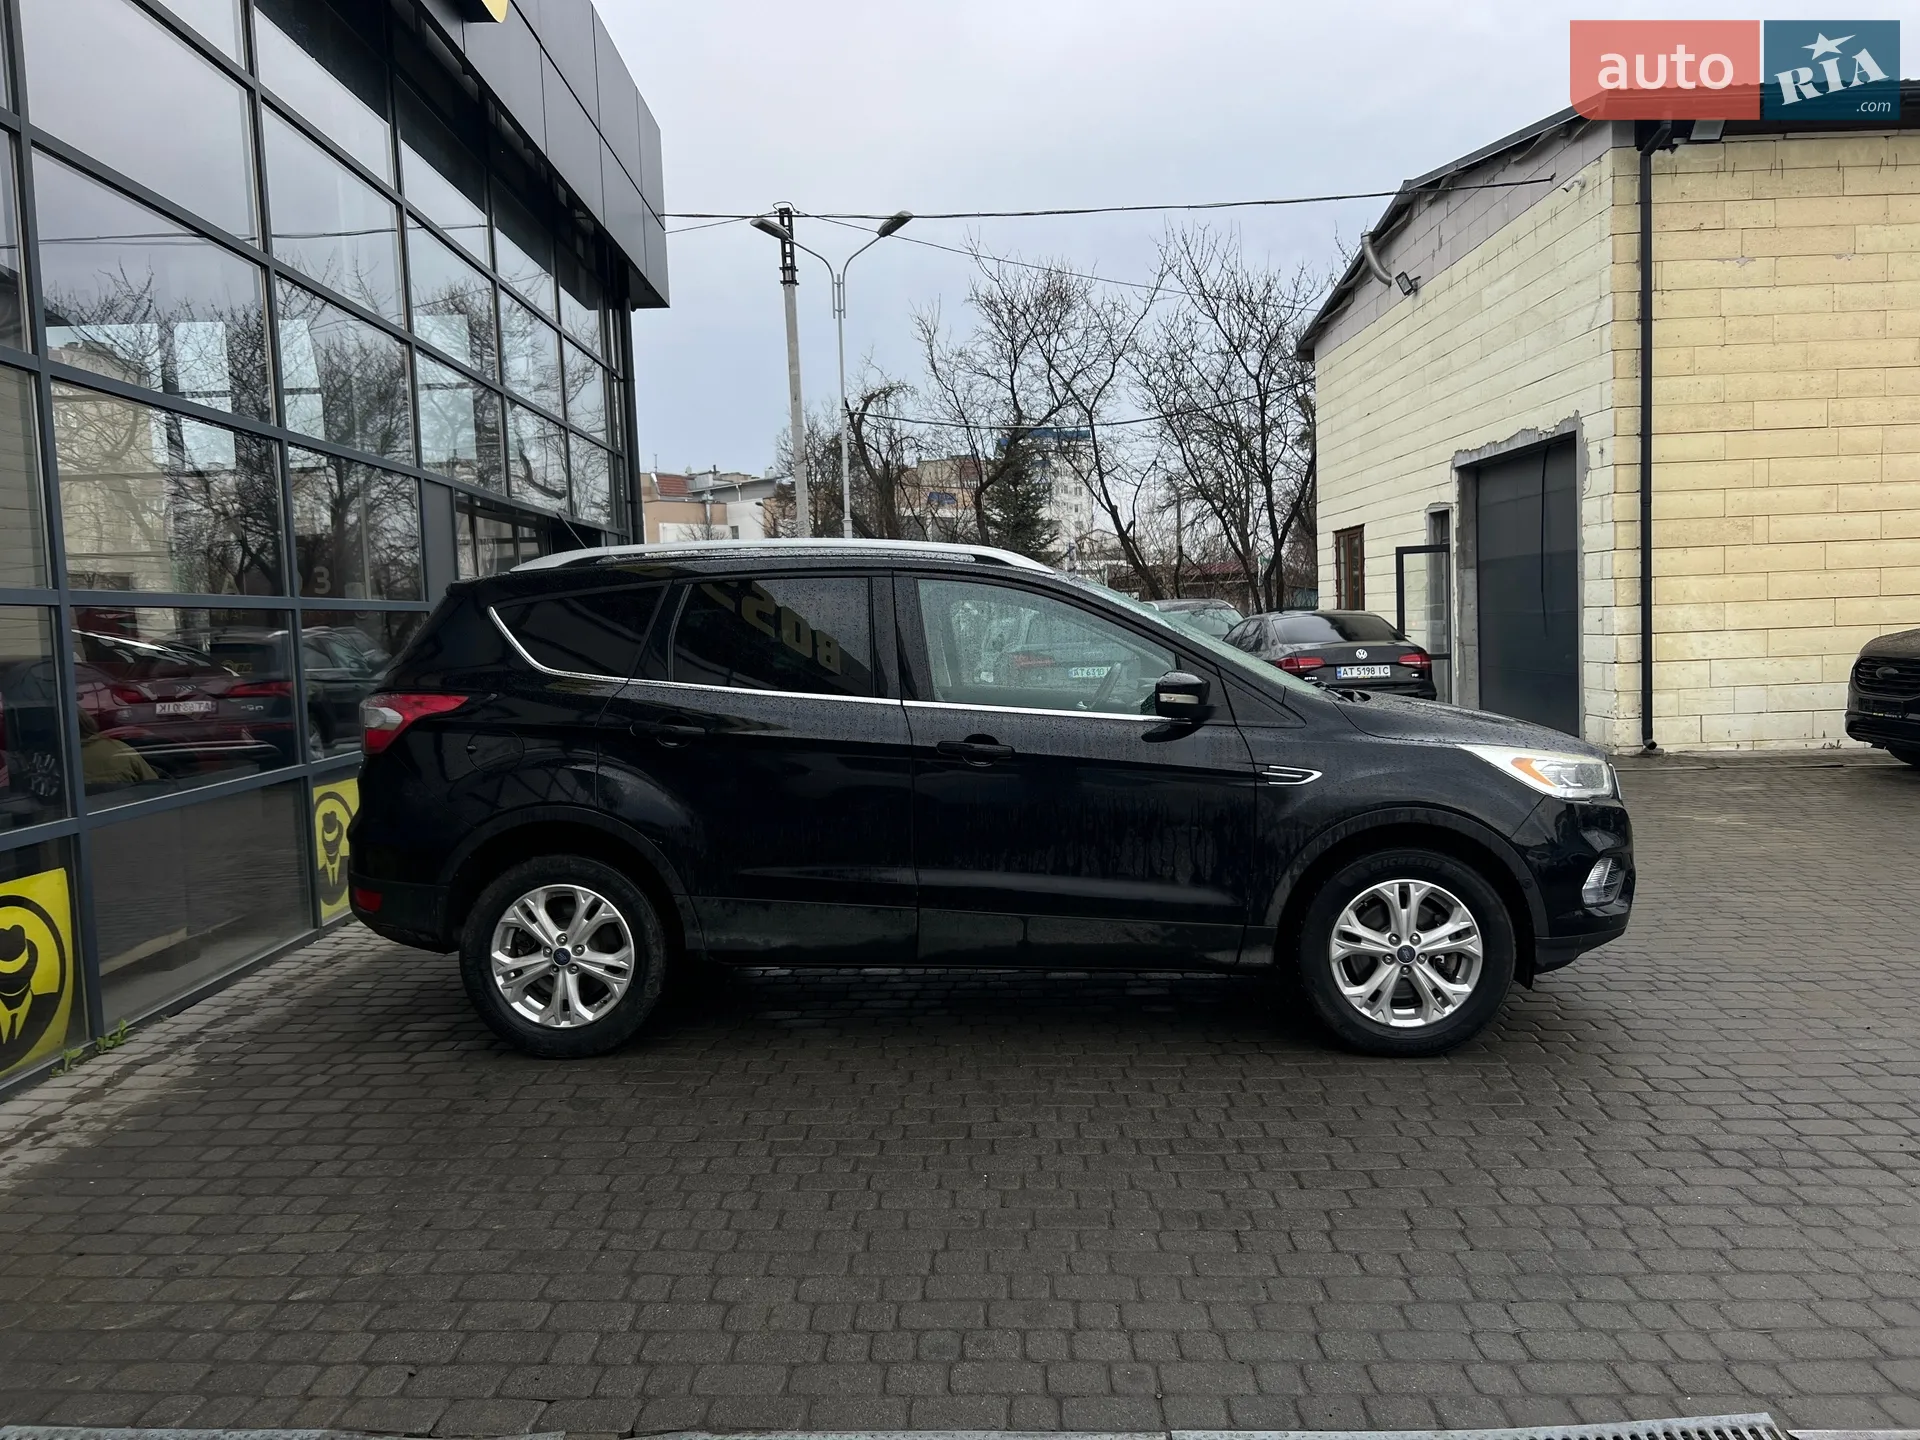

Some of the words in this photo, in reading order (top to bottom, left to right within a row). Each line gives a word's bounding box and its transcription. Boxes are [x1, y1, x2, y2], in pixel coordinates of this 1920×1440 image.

[1342, 667, 1355, 676] AT
[1356, 666, 1376, 676] 5198
[1378, 666, 1389, 675] IC
[1369, 855, 1442, 872] MICHELIN
